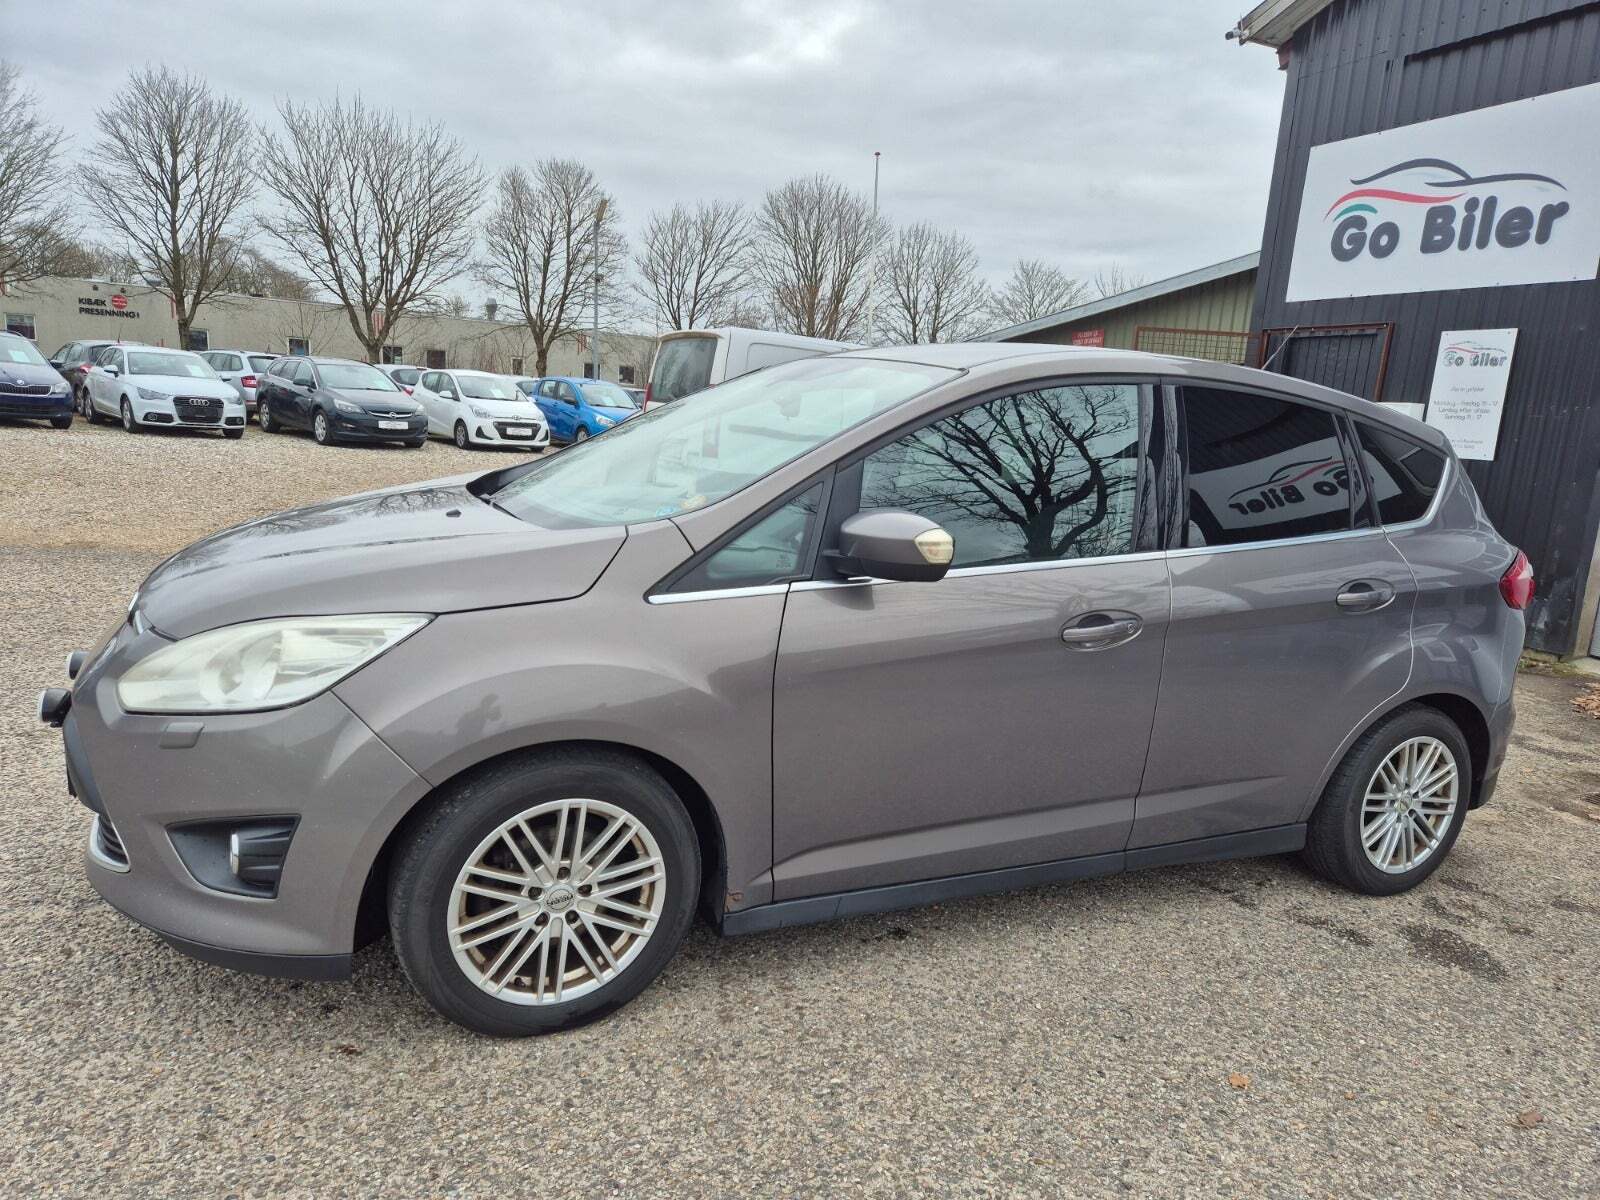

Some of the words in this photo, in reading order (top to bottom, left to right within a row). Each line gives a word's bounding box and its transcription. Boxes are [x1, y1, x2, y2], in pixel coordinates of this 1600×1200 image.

[1331, 214, 1399, 262] Go
[1420, 196, 1569, 254] Biler
[79, 298, 106, 306] KIBÆK
[79, 307, 135, 318] PRESENNING
